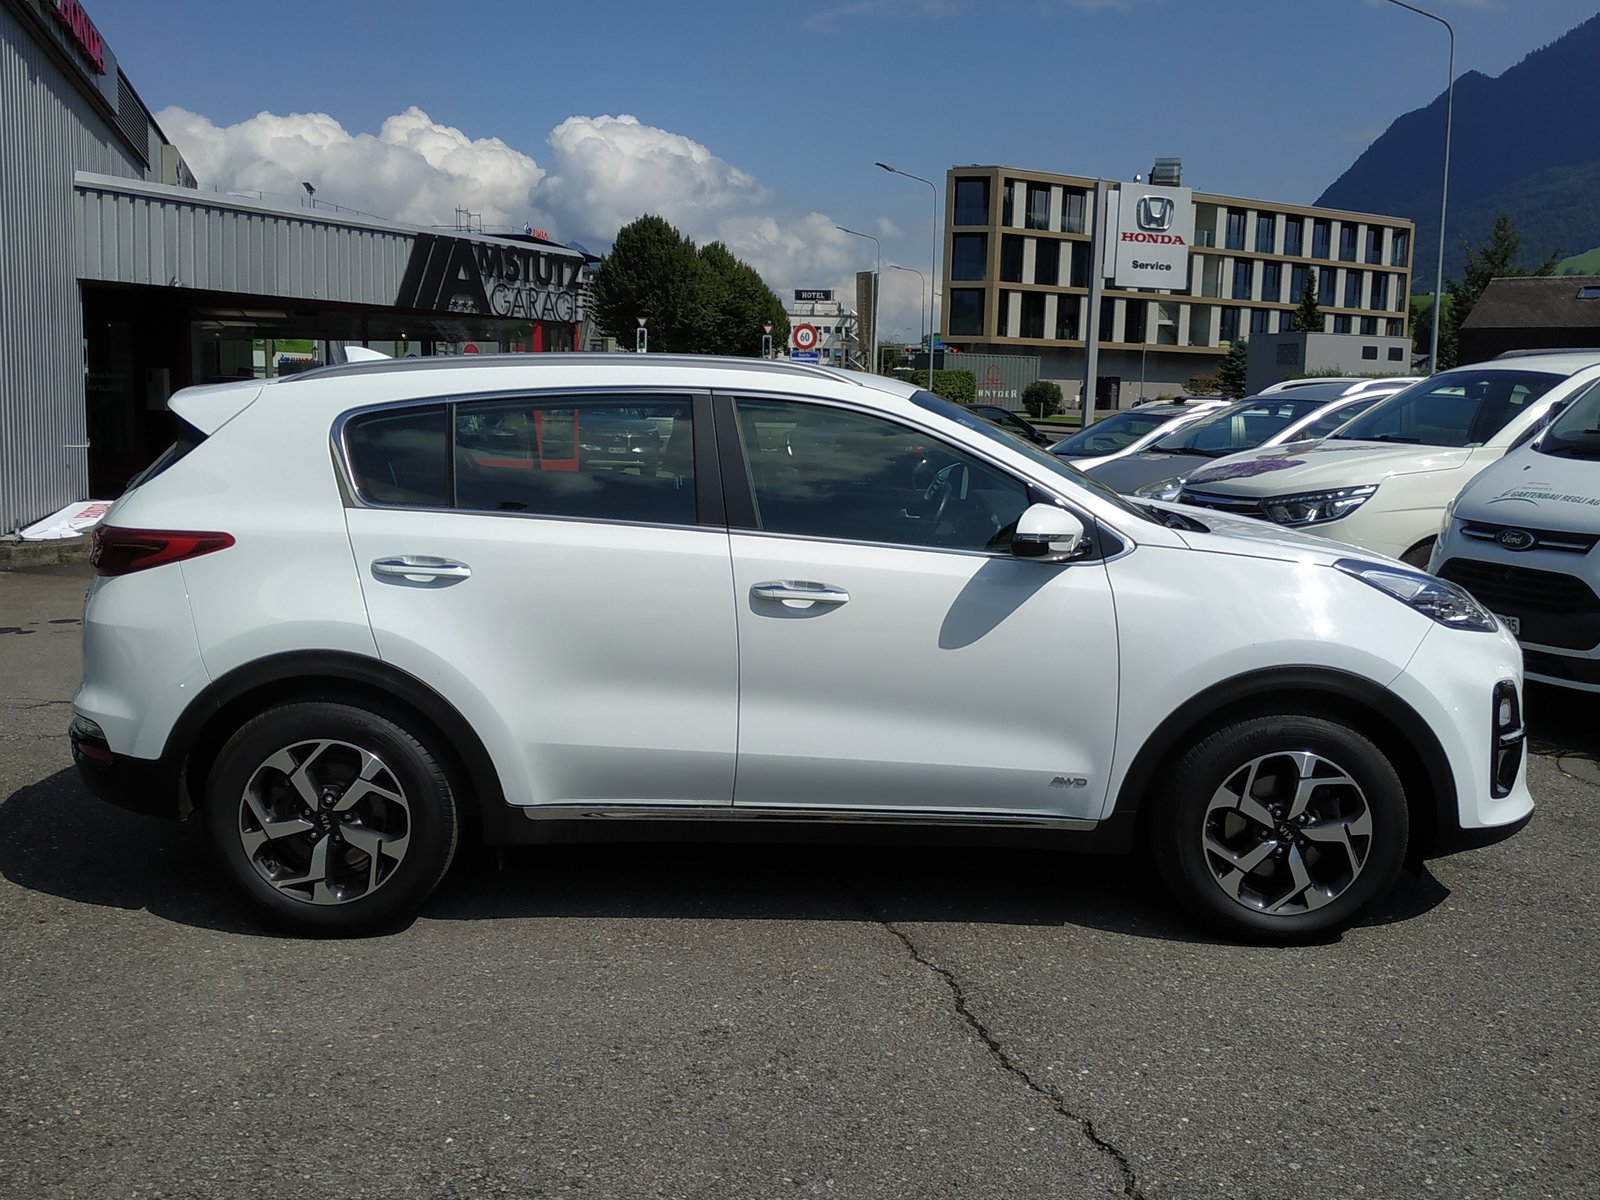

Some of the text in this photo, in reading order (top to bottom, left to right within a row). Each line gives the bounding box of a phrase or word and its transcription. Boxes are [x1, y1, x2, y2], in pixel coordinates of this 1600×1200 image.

[1120, 231, 1186, 246] HONDA
[1131, 260, 1172, 271] Service
[437, 238, 584, 313] AMSTUTZ
[801, 291, 825, 299] HOTEL
[490, 283, 584, 324] GARAGE
[799, 331, 810, 342] 60
[1510, 490, 1600, 507] GARTENBAU REGLI AG
[1502, 531, 1523, 545] Ford
[1050, 776, 1088, 787] AWD
[320, 813, 332, 831] KIA
[1279, 824, 1294, 841] KIA
